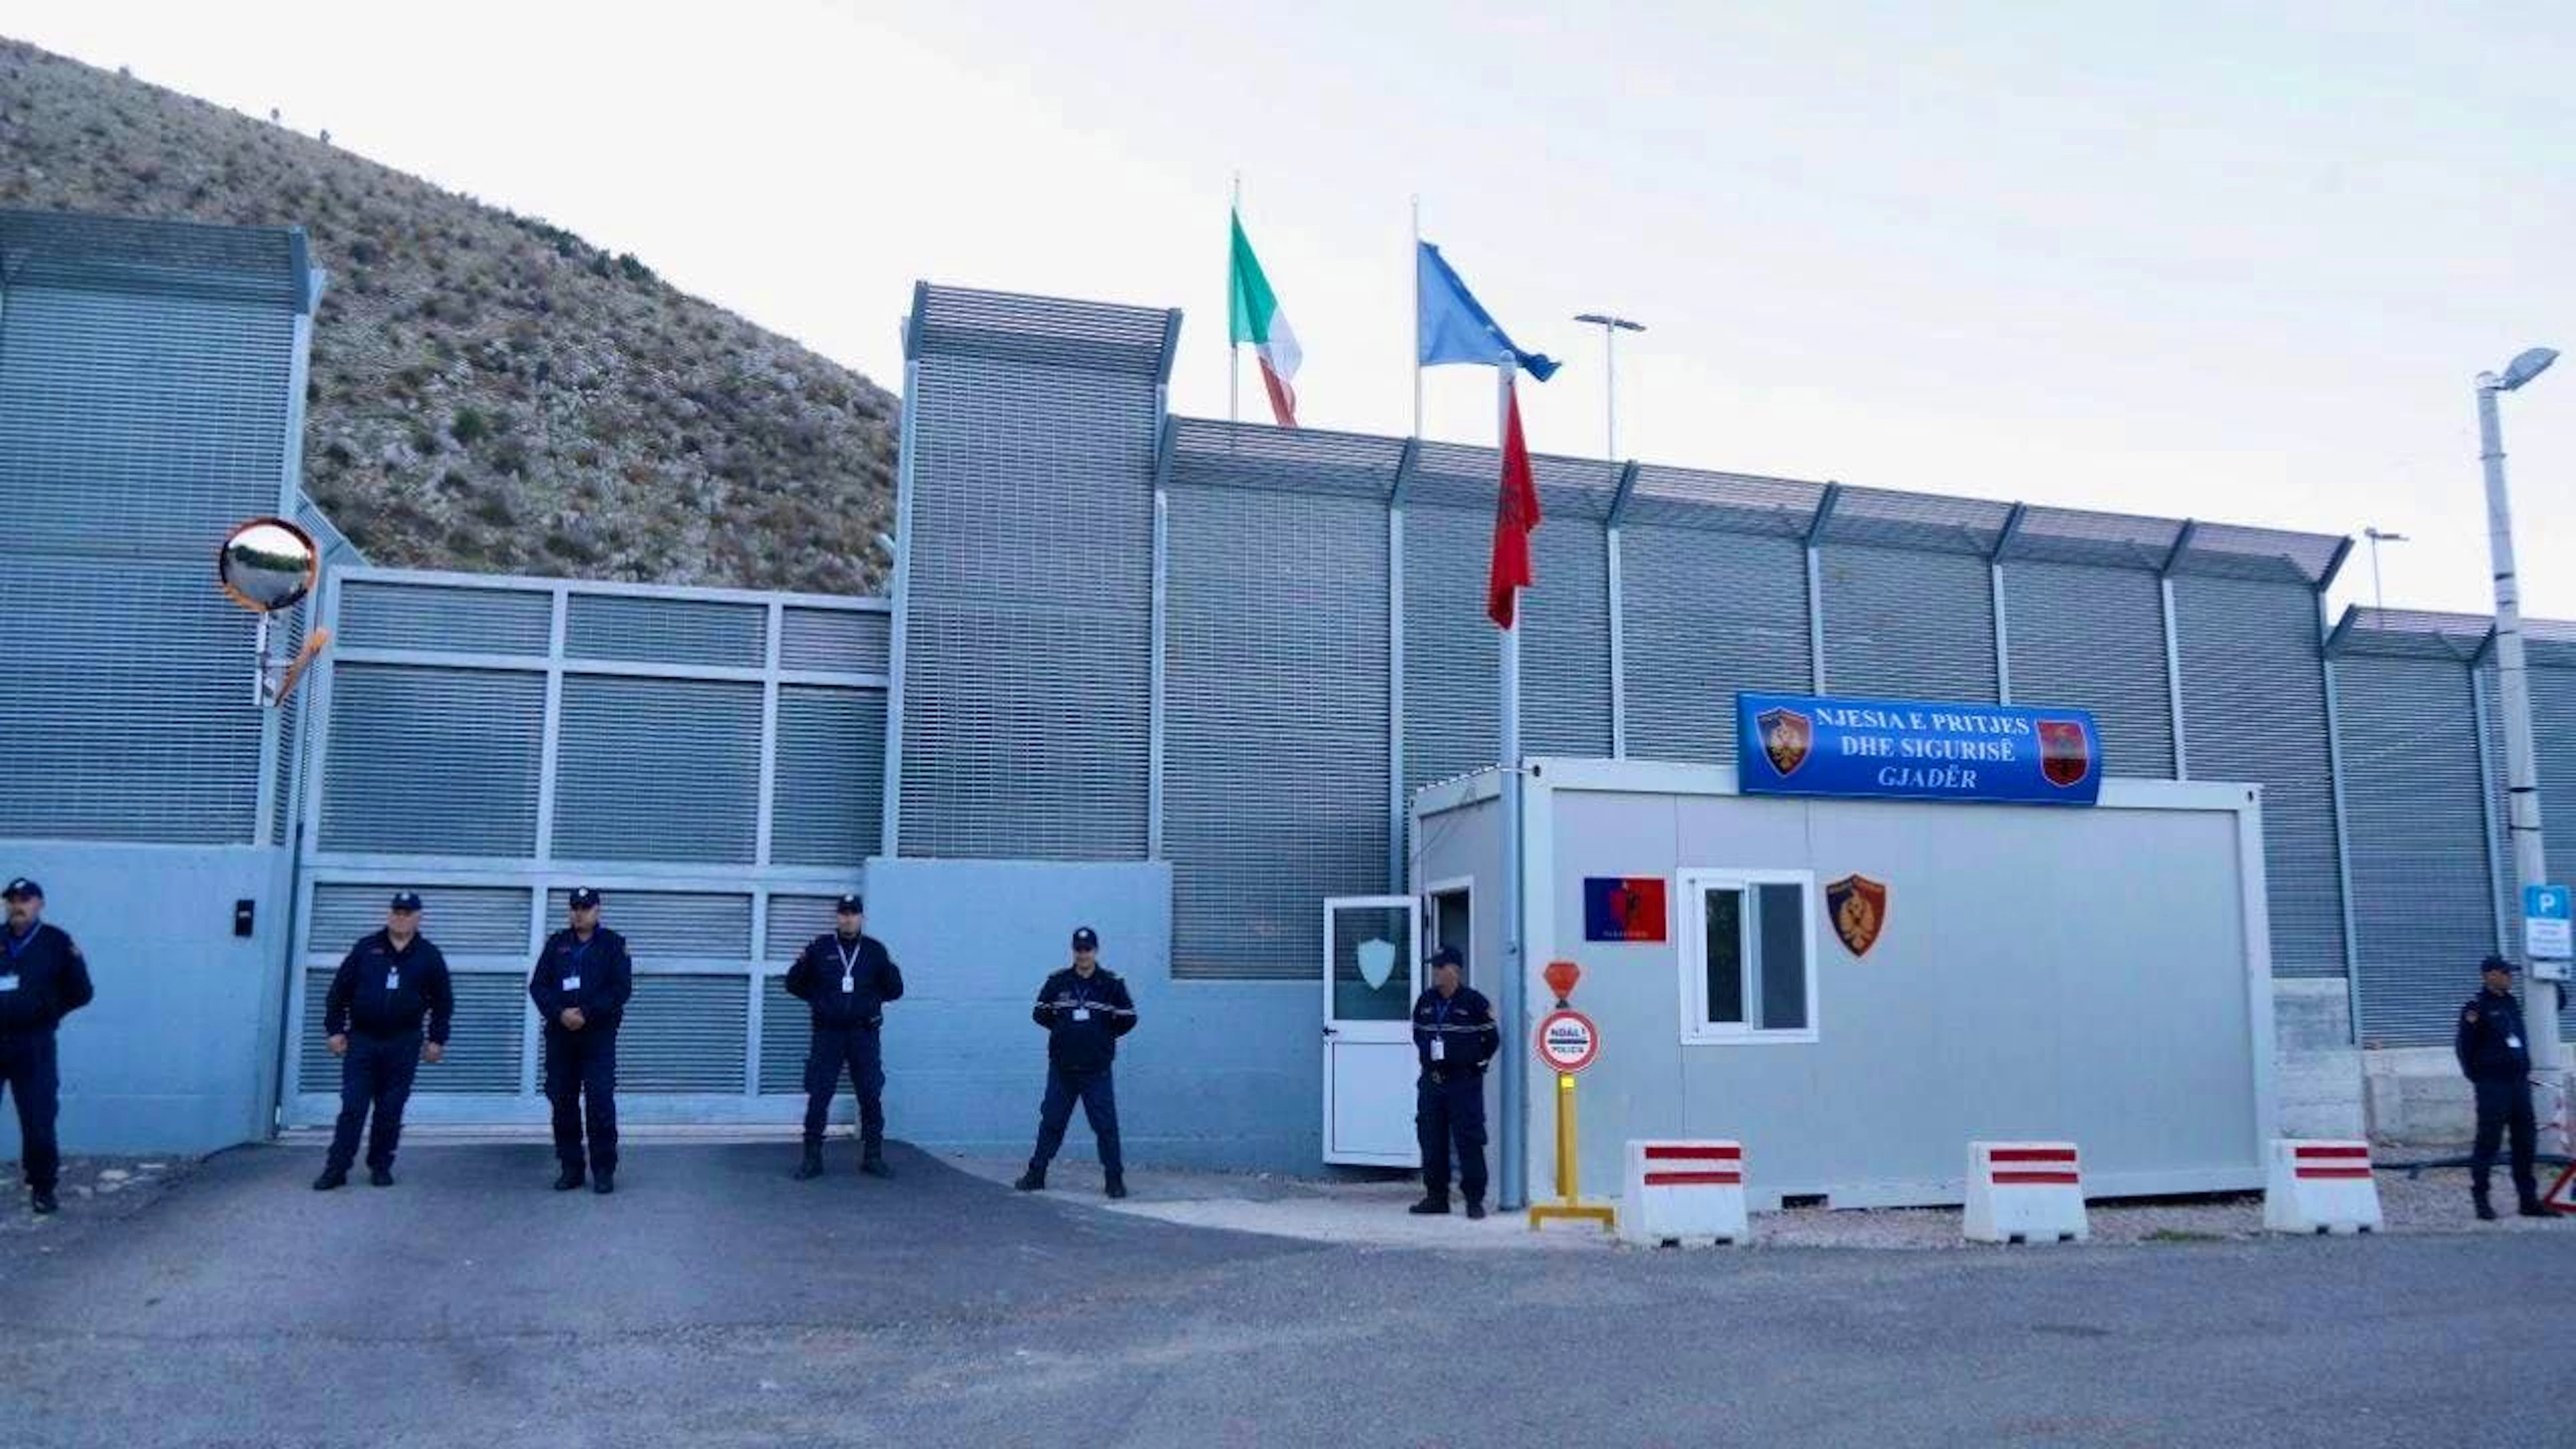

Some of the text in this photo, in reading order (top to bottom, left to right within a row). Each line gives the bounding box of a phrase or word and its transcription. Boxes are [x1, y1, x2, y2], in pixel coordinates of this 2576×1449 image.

[1815, 708, 2030, 735] NJESIA E PRITJES
[1841, 736, 2015, 762] DHE SIGURISË
[1878, 764, 1977, 788] GJADËR
[2539, 892, 2555, 913] P
